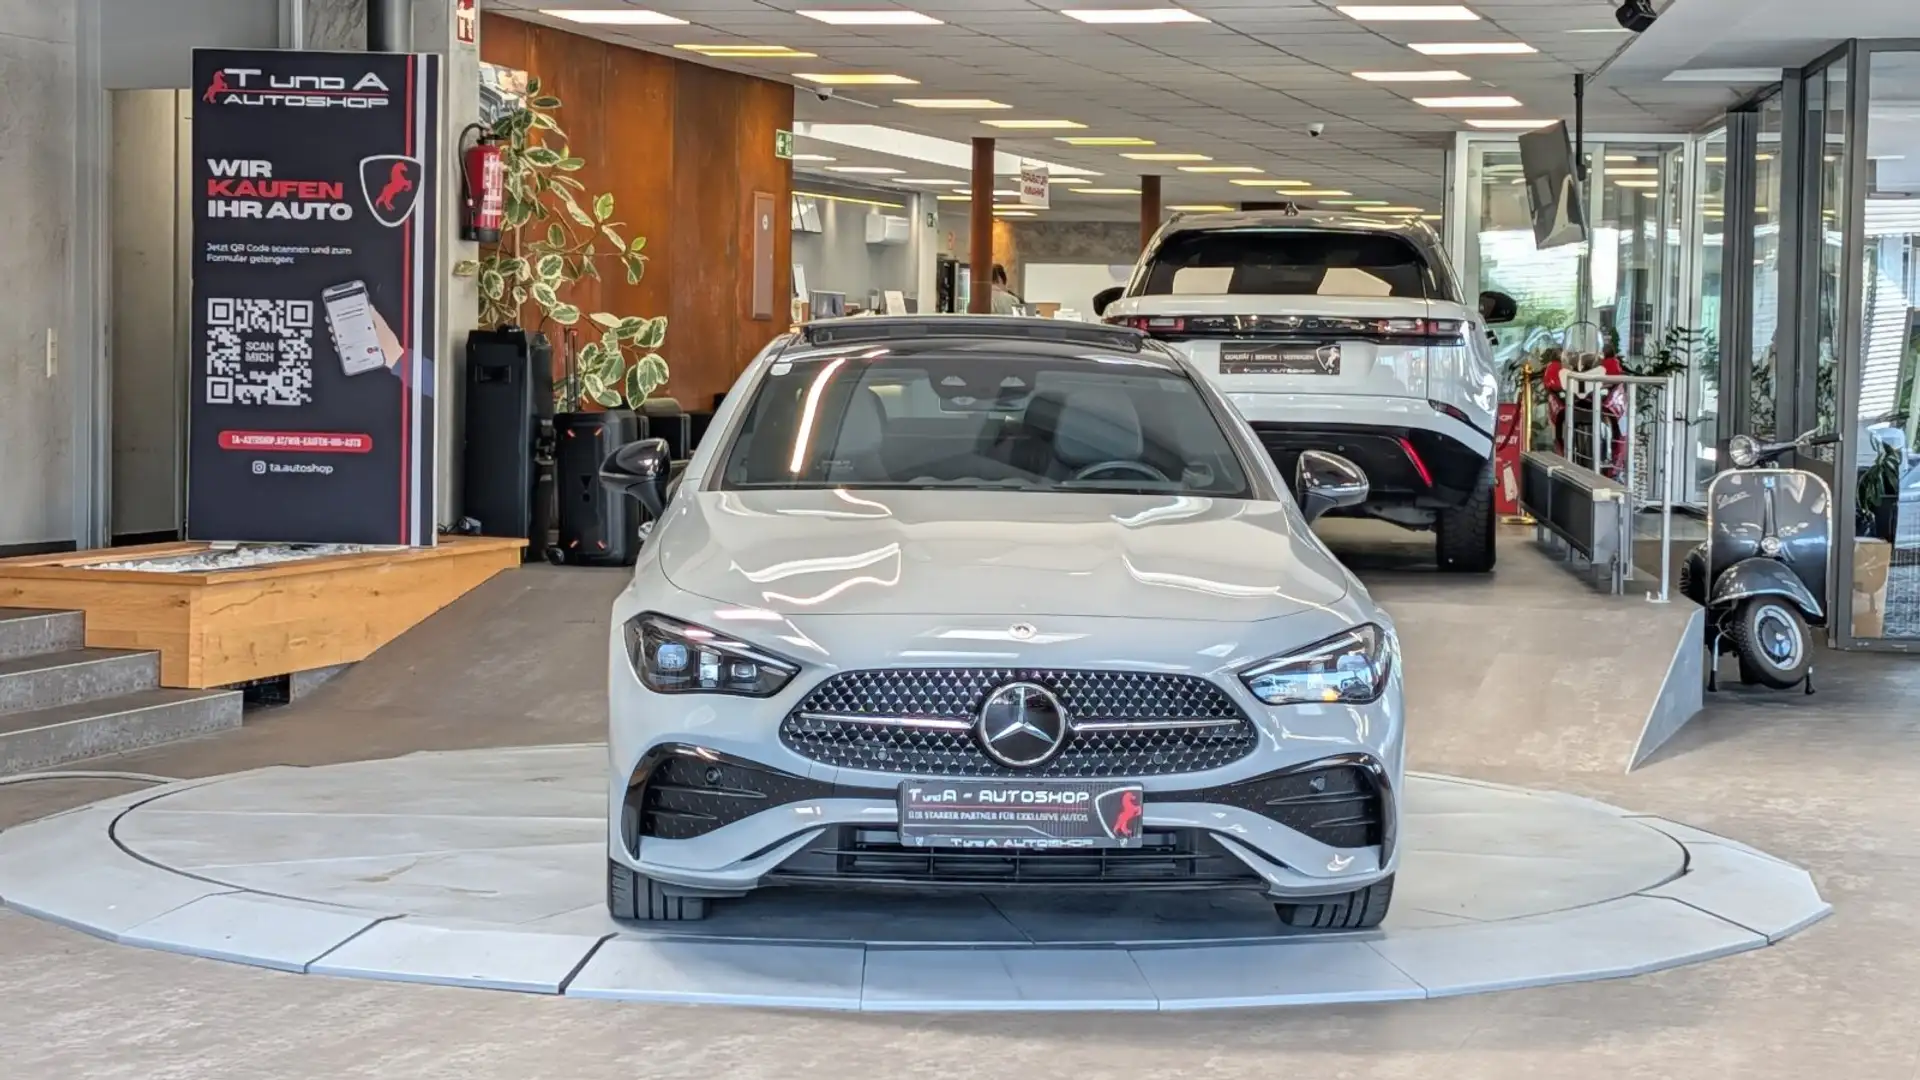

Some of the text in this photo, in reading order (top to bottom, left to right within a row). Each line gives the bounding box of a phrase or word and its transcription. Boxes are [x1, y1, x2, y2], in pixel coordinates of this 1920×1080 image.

[223, 68, 262, 88] T
[352, 71, 390, 92] A
[223, 94, 389, 109] AUTOSHOP
[207, 158, 273, 178] WIR
[207, 179, 344, 200] KAUFEN
[207, 200, 353, 222] IHR AUTO
[206, 243, 353, 255] Jetzt QR Code scannen und zum
[206, 253, 248, 263] Formular
[245, 341, 275, 352] SCAN
[245, 352, 275, 363] MICH
[269, 463, 334, 475] ta.autoshop
[979, 789, 1090, 804] AUTOSHOP
[924, 811, 959, 820] STARKER
[960, 811, 998, 821] PARTNER
[999, 810, 1015, 821] FÜR
[1060, 812, 1089, 822] AUTOS
[1003, 838, 1094, 848] AUTOSHOP
